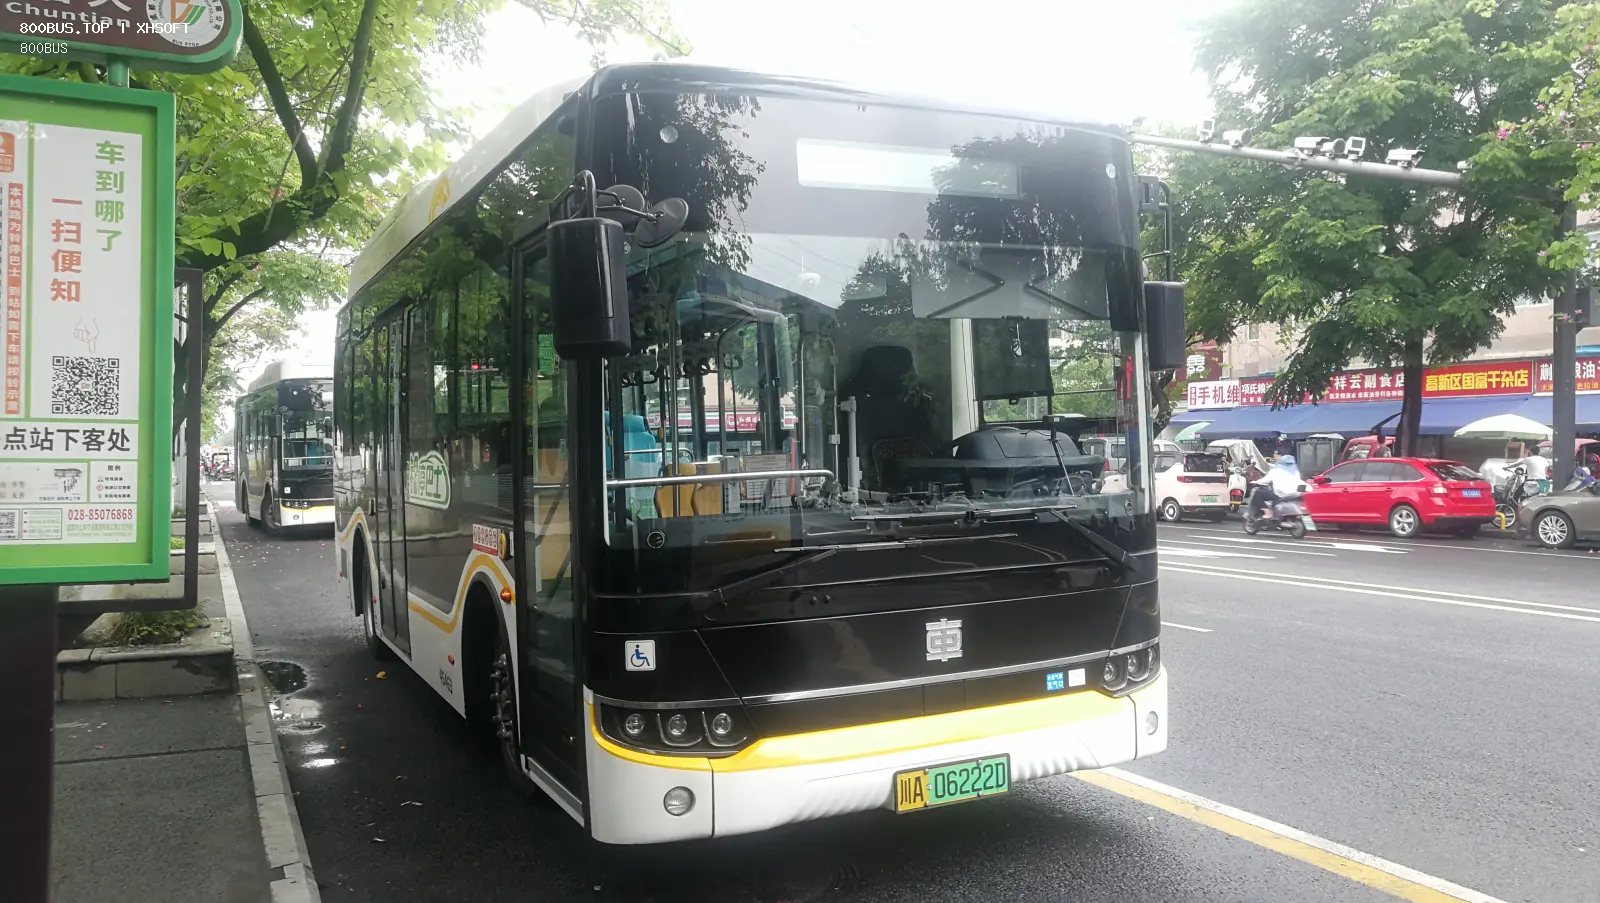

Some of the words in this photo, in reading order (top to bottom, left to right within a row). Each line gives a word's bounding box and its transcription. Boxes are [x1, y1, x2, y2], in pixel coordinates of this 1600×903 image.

[6, 2, 130, 27] Chuntian
[95, 140, 125, 252] 车到哪了
[50, 197, 83, 302] 一扫便知
[1334, 372, 1405, 390] 祥云副食店
[1425, 369, 1529, 392] 高新区国富干杂店
[1197, 384, 1240, 405] 手机维
[3, 426, 131, 452] 点站下客处
[68, 509, 133, 520] 028-85076868
[900, 776, 924, 805] 川A
[934, 762, 1006, 798] 06222D
